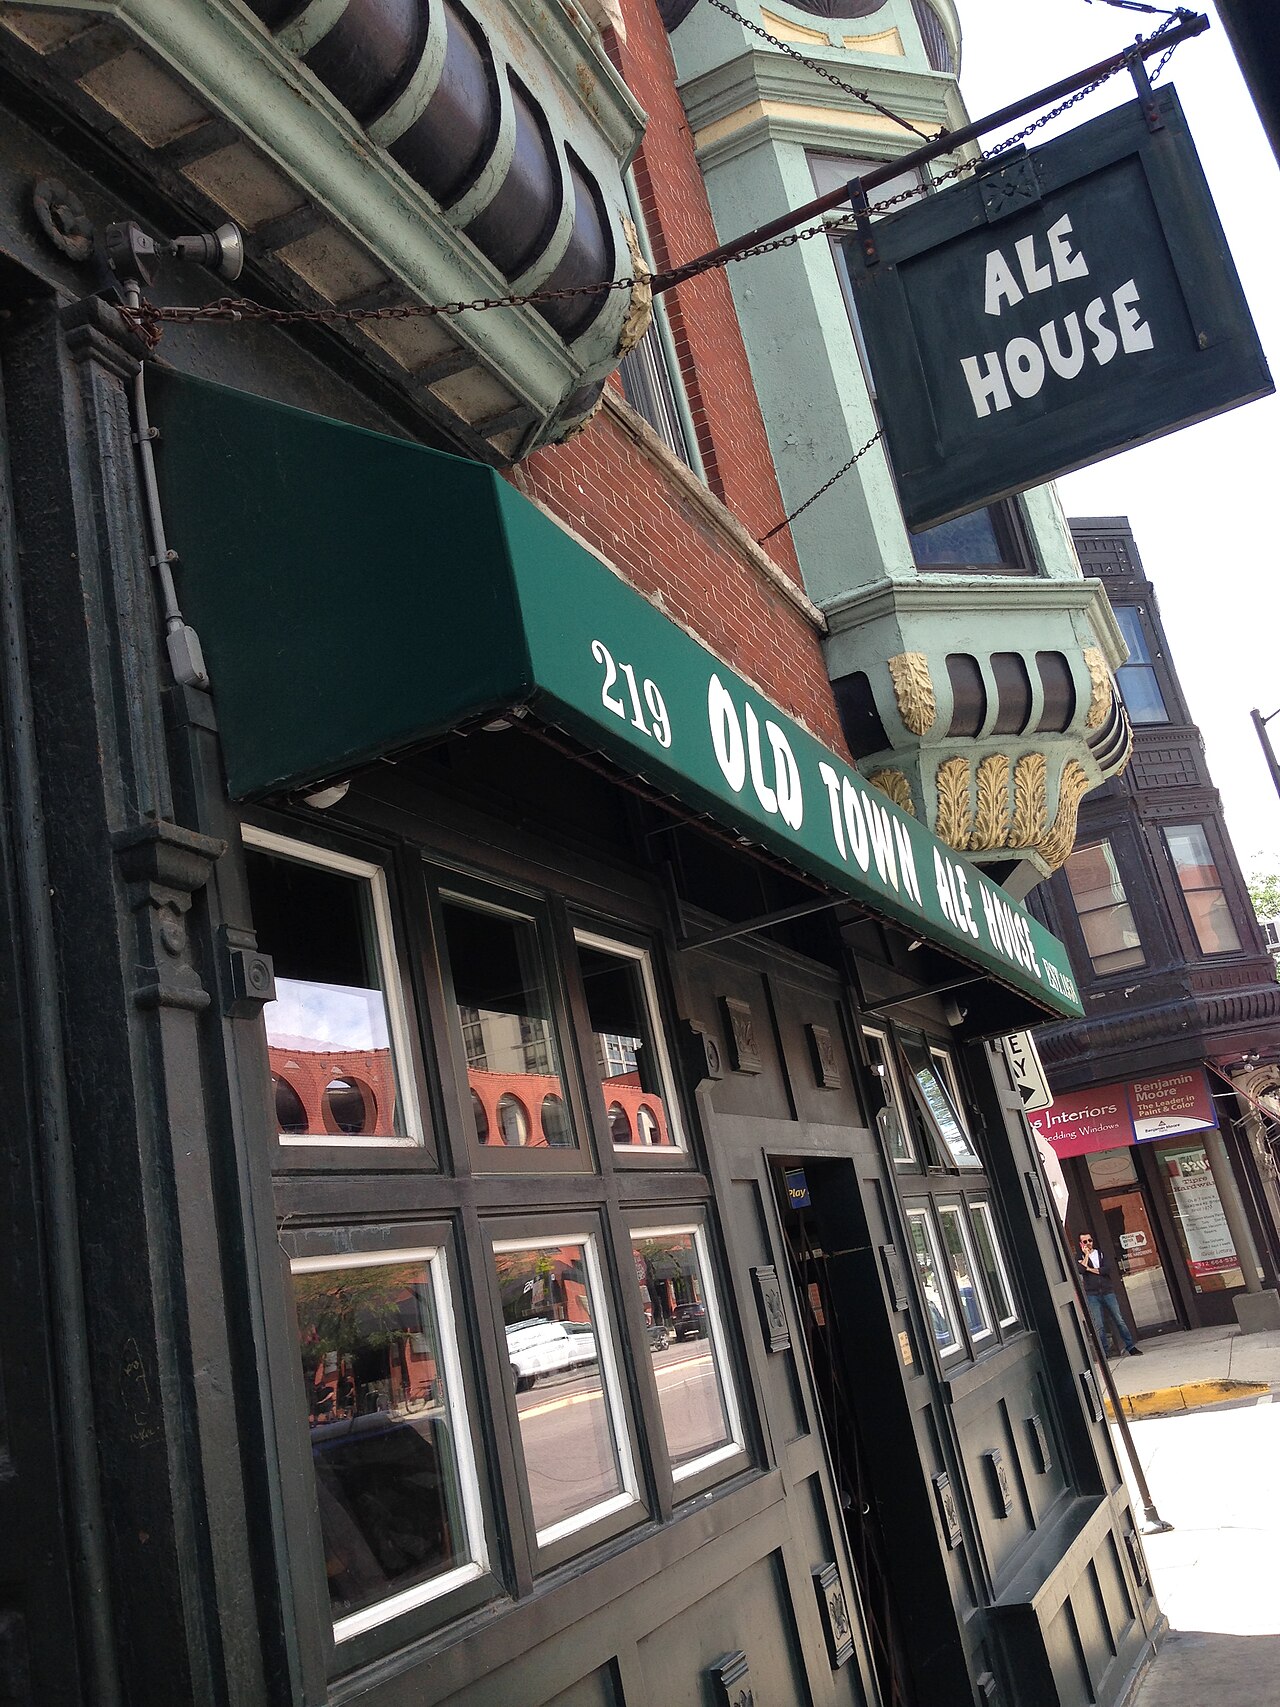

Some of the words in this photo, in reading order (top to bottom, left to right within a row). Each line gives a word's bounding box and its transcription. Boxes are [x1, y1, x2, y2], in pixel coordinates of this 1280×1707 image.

[985, 213, 1089, 316] ALE
[960, 278, 1154, 419] HOUSE
[591, 639, 672, 749] 219
[708, 673, 804, 831] OLD
[818, 761, 923, 908] TOWN
[933, 845, 979, 939] ALE
[979, 880, 1042, 979] HOUSE
[1134, 1074, 1193, 1093] Benjamin
[1136, 1087, 1177, 1102] Moore
[1137, 1103, 1154, 1111] The
[1155, 1097, 1185, 1108] Leader
[1138, 1108, 1162, 1117] Paint
[1171, 1101, 1195, 1111] Color
[1045, 1104, 1118, 1129] Interiors
[1078, 1123, 1120, 1136] Windows
[788, 1188, 806, 1198] Play
